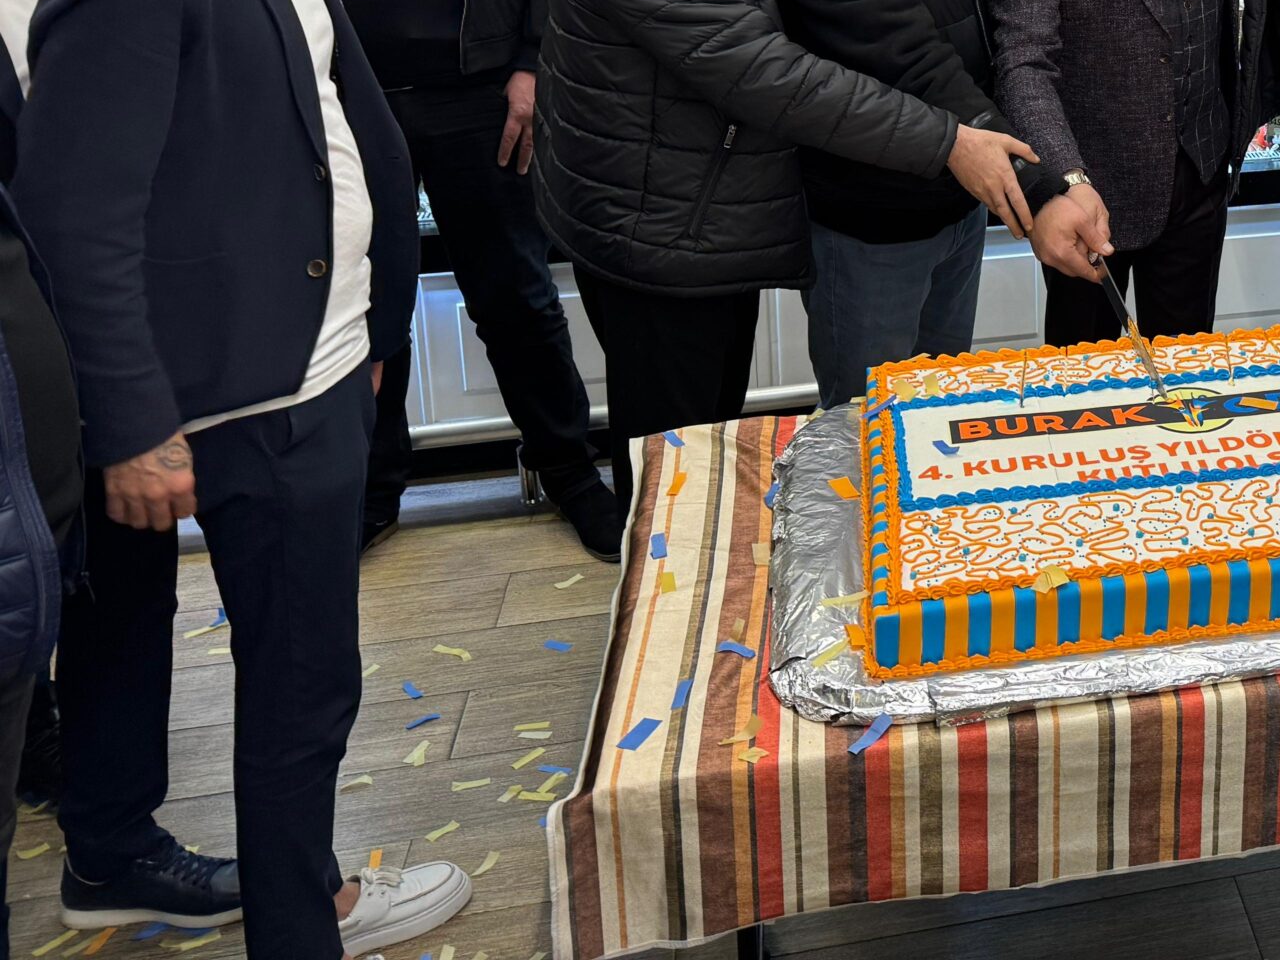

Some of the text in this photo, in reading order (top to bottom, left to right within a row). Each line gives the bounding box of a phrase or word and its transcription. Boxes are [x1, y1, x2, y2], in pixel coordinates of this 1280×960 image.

[958, 405, 1156, 440] BURAK
[918, 465, 954, 481] 4.
[963, 445, 1152, 477] KURULUŞ
